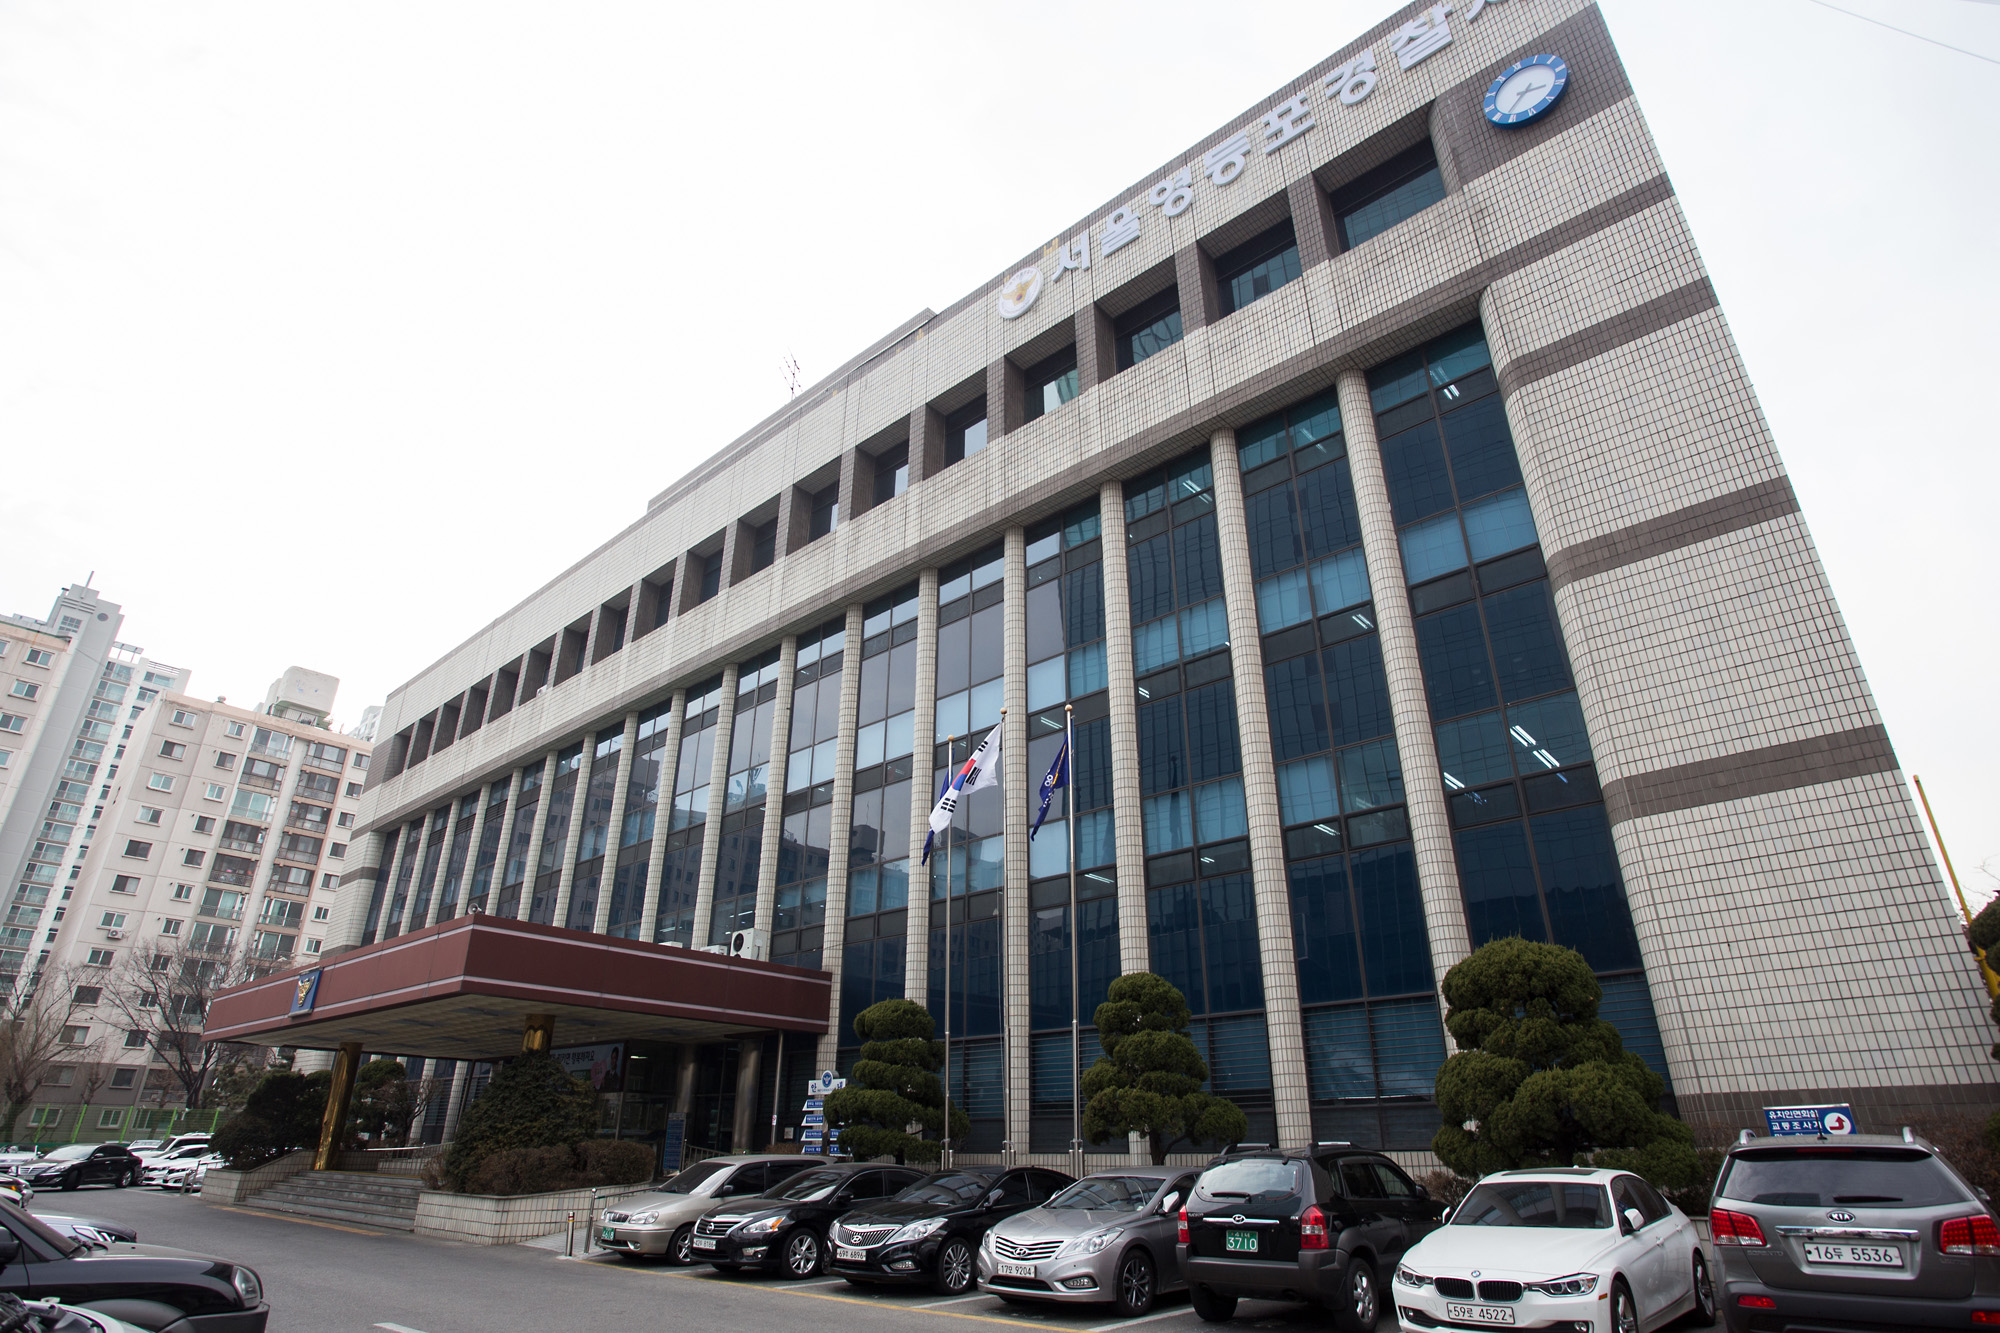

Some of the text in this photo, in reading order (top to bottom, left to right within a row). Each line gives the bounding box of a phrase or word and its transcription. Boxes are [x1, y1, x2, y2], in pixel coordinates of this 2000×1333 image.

[1768, 1109, 1819, 1120] 유치인면회실
[1831, 1213, 1851, 1221] KIA
[1228, 1236, 1257, 1250] 3710
[1813, 1246, 1893, 1263] 16두 5536
[1015, 1265, 1032, 1276] 9204
[1453, 1305, 1508, 1321] 59로 4522
